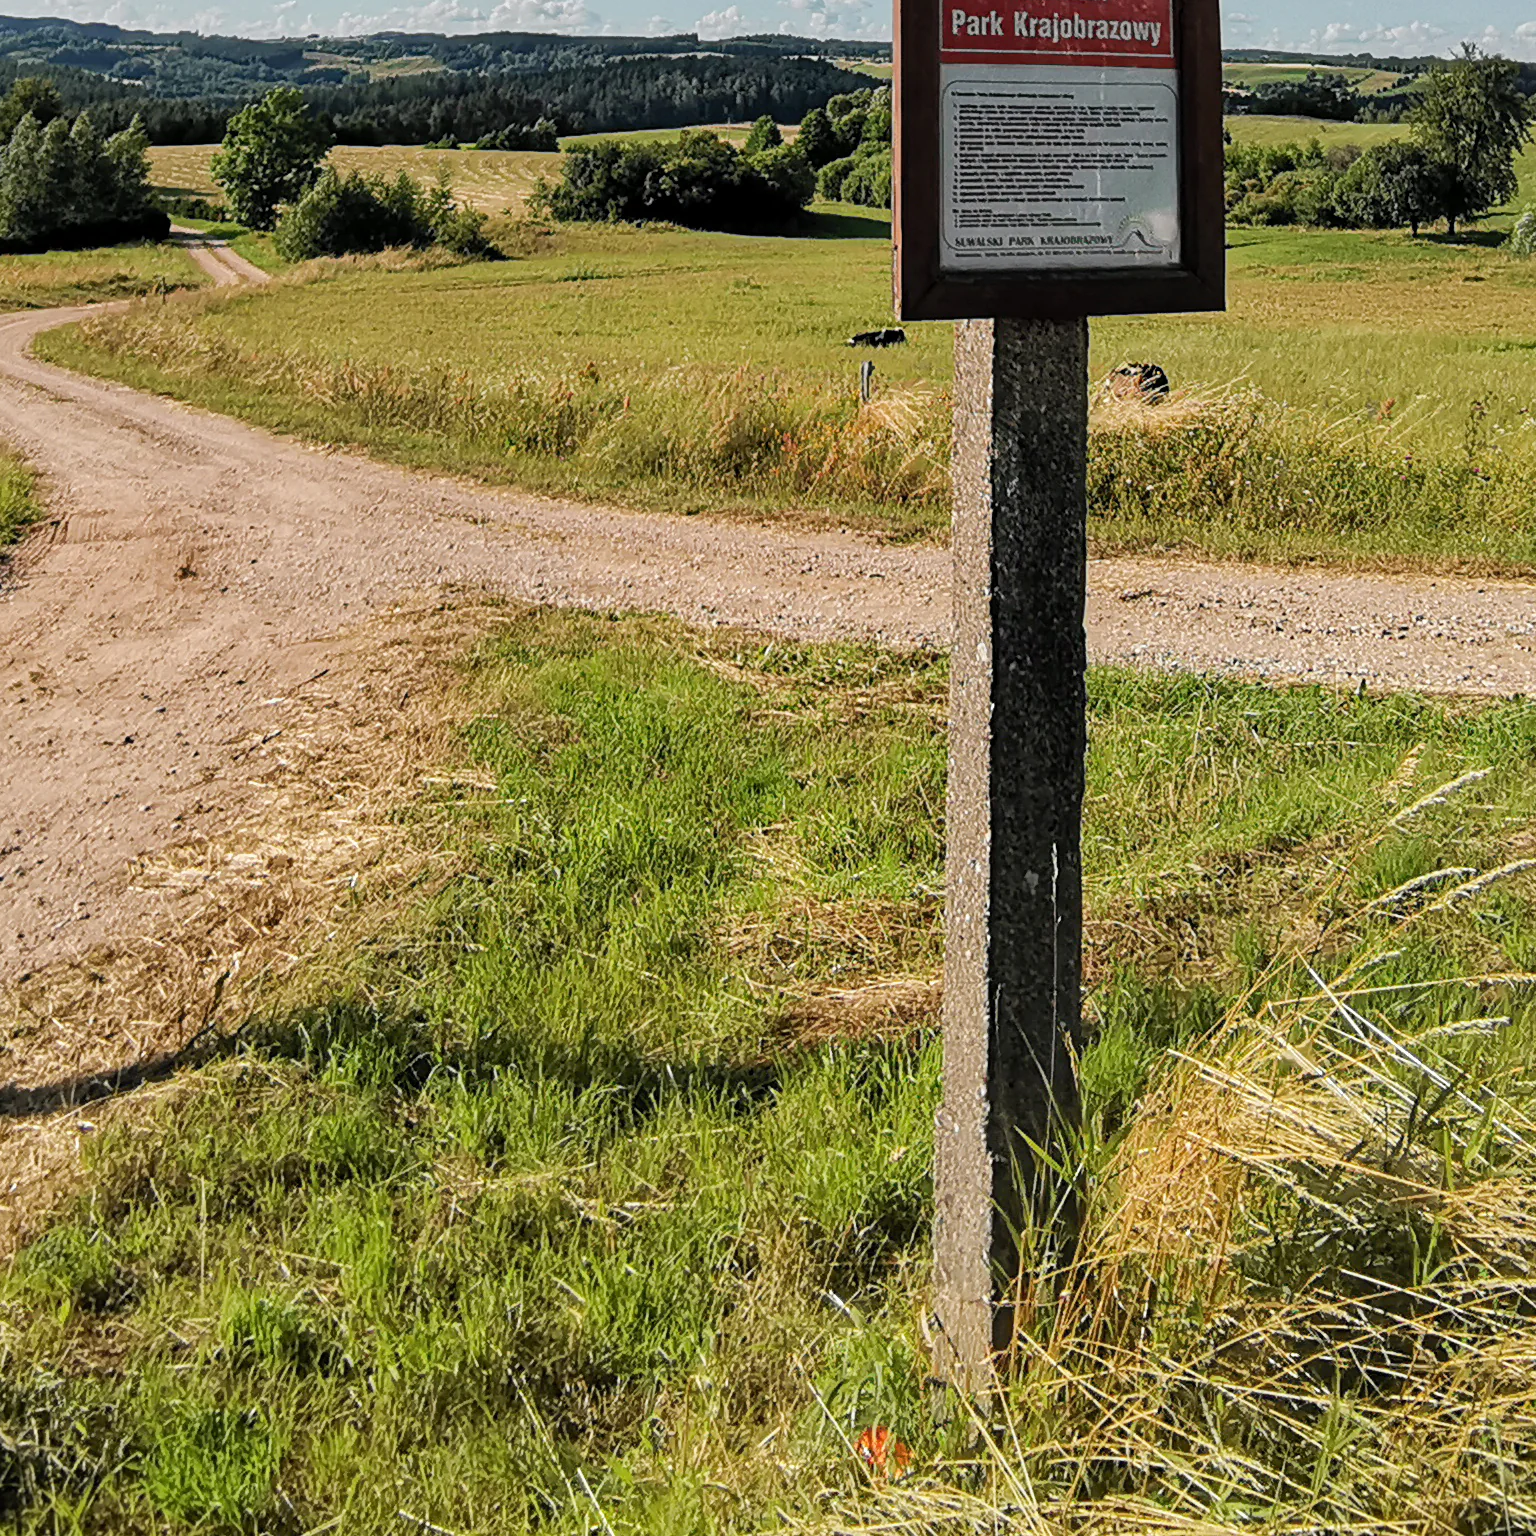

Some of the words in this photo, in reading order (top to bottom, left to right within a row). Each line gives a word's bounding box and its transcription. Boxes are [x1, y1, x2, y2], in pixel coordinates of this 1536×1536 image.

[951, 9, 1004, 36] Park
[1014, 11, 1161, 46] Krajobrazowy
[955, 236, 1003, 247] SUWALSKI
[1008, 236, 1034, 246] PARK
